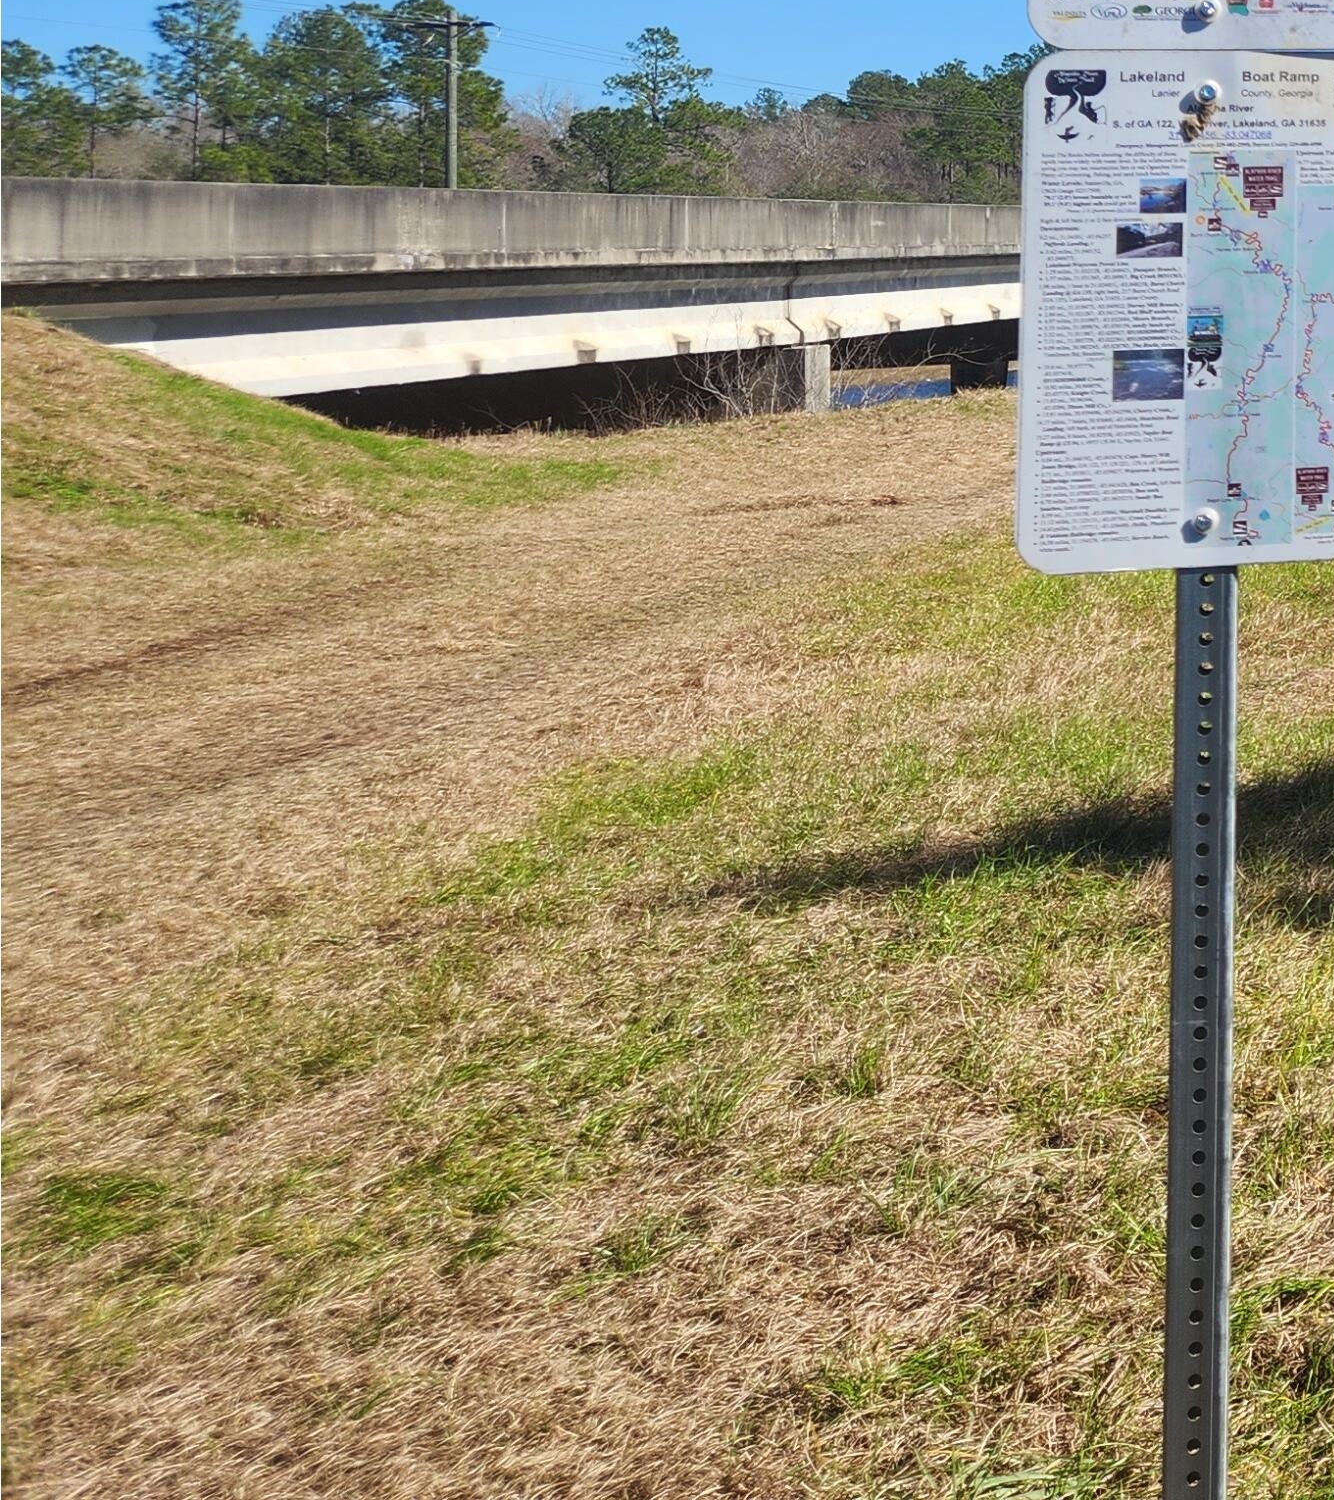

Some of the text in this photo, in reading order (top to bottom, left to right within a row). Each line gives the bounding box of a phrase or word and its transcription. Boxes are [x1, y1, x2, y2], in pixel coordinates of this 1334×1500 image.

[1120, 71, 1320, 85] Lakeland Boat Ramp
[1151, 88, 1314, 100] Lanier County, Georgia
[1229, 104, 1254, 112] River
[1112, 120, 1122, 129] S.
[1124, 119, 1134, 128] of
[1137, 120, 1152, 128] GA
[1156, 120, 1175, 130] 122,
[1233, 119, 1278, 129] Lakeland,
[1281, 119, 1296, 127] GA
[1299, 119, 1326, 127] 31635
